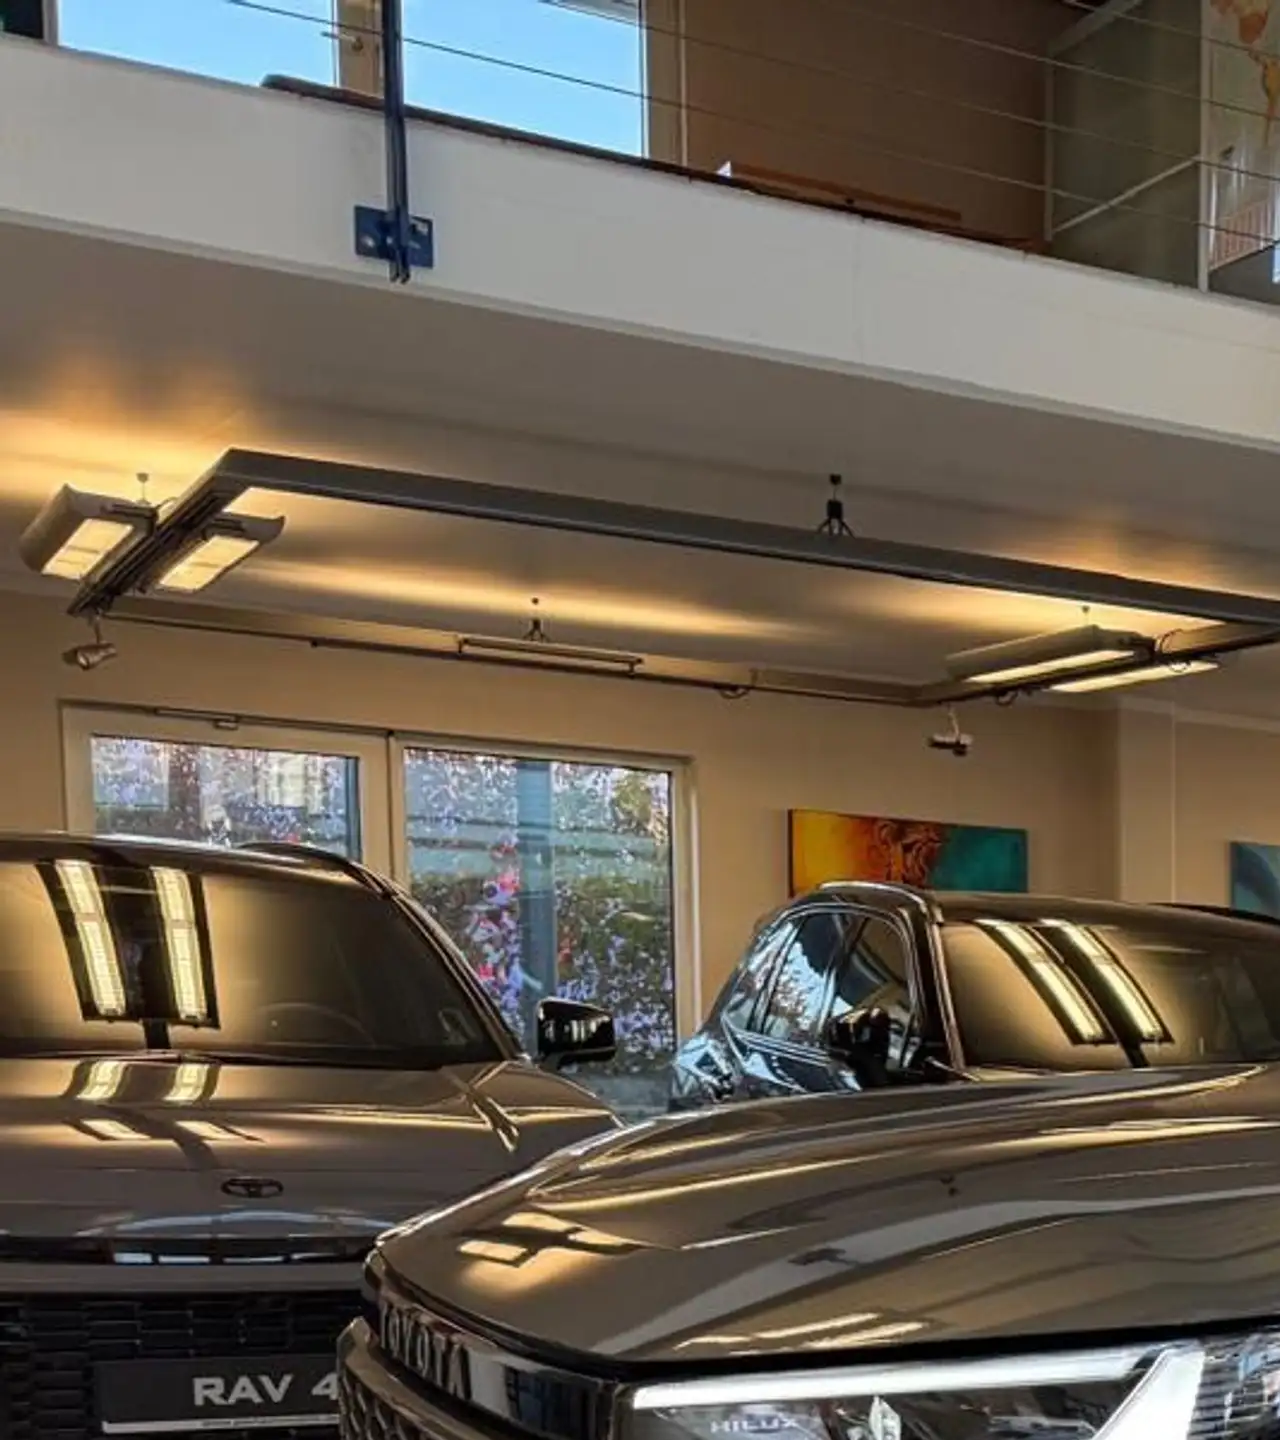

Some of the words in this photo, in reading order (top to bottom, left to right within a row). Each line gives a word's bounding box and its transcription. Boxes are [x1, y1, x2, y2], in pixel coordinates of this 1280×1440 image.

[379, 1297, 472, 1400] TOYOTA
[192, 1373, 294, 1406] RAV
[311, 1371, 340, 1401] 4
[709, 1412, 799, 1434] HILUX
